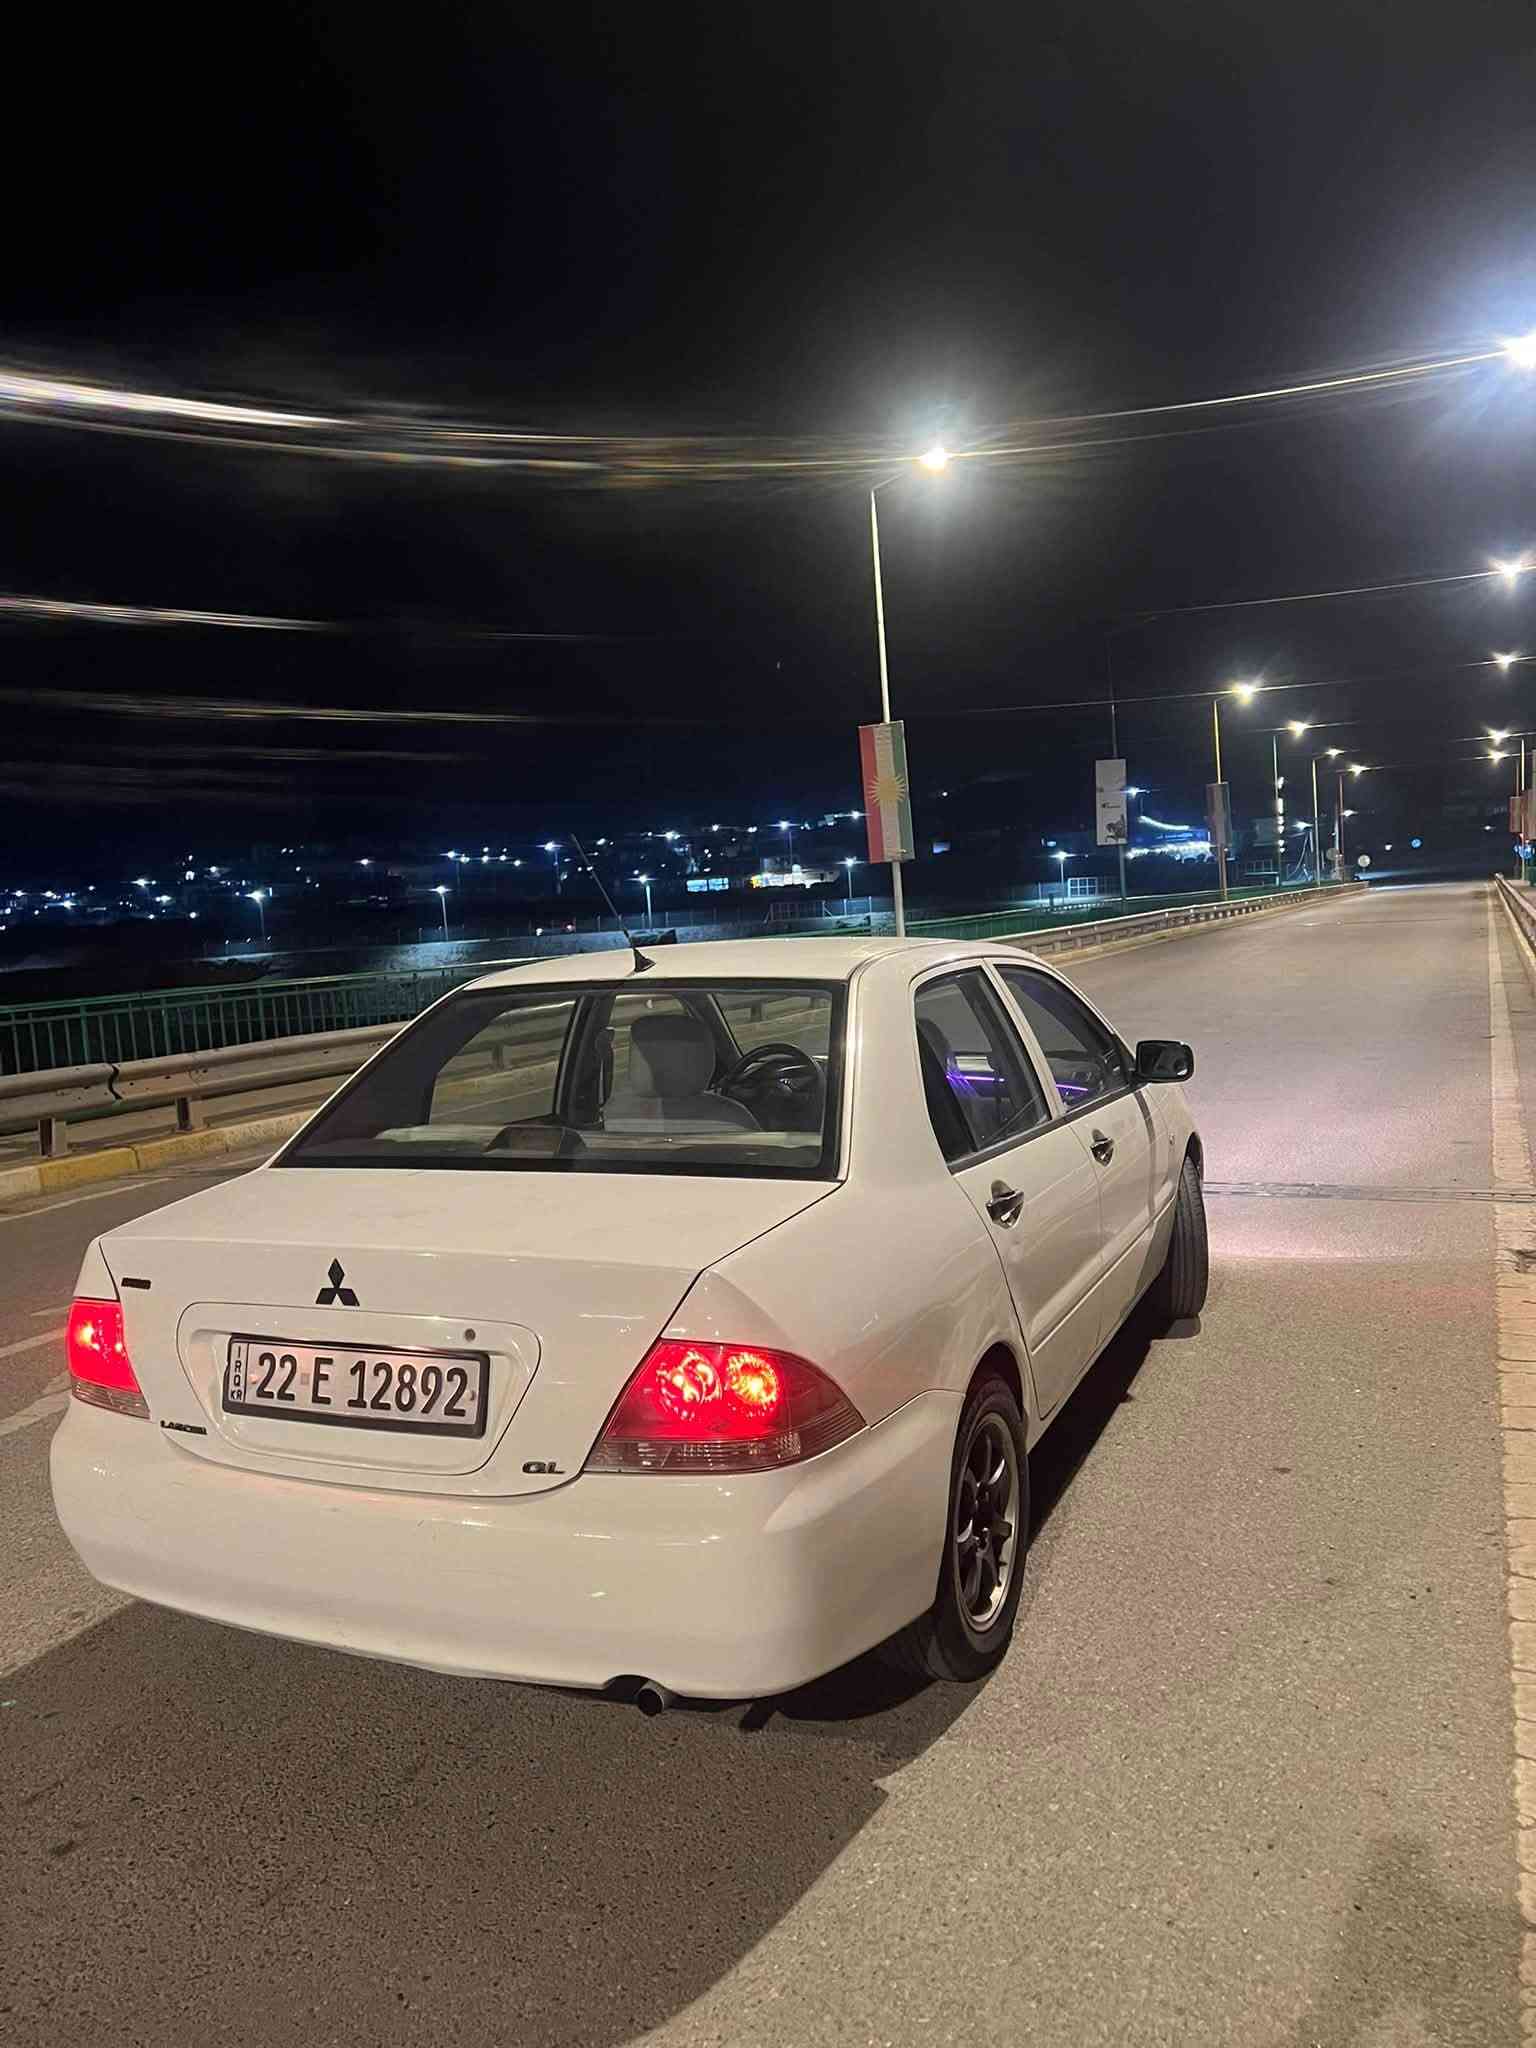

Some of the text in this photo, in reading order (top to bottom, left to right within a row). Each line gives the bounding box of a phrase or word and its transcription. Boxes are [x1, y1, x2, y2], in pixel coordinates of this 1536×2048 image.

[256, 1352, 468, 1417] 22 E 12892
